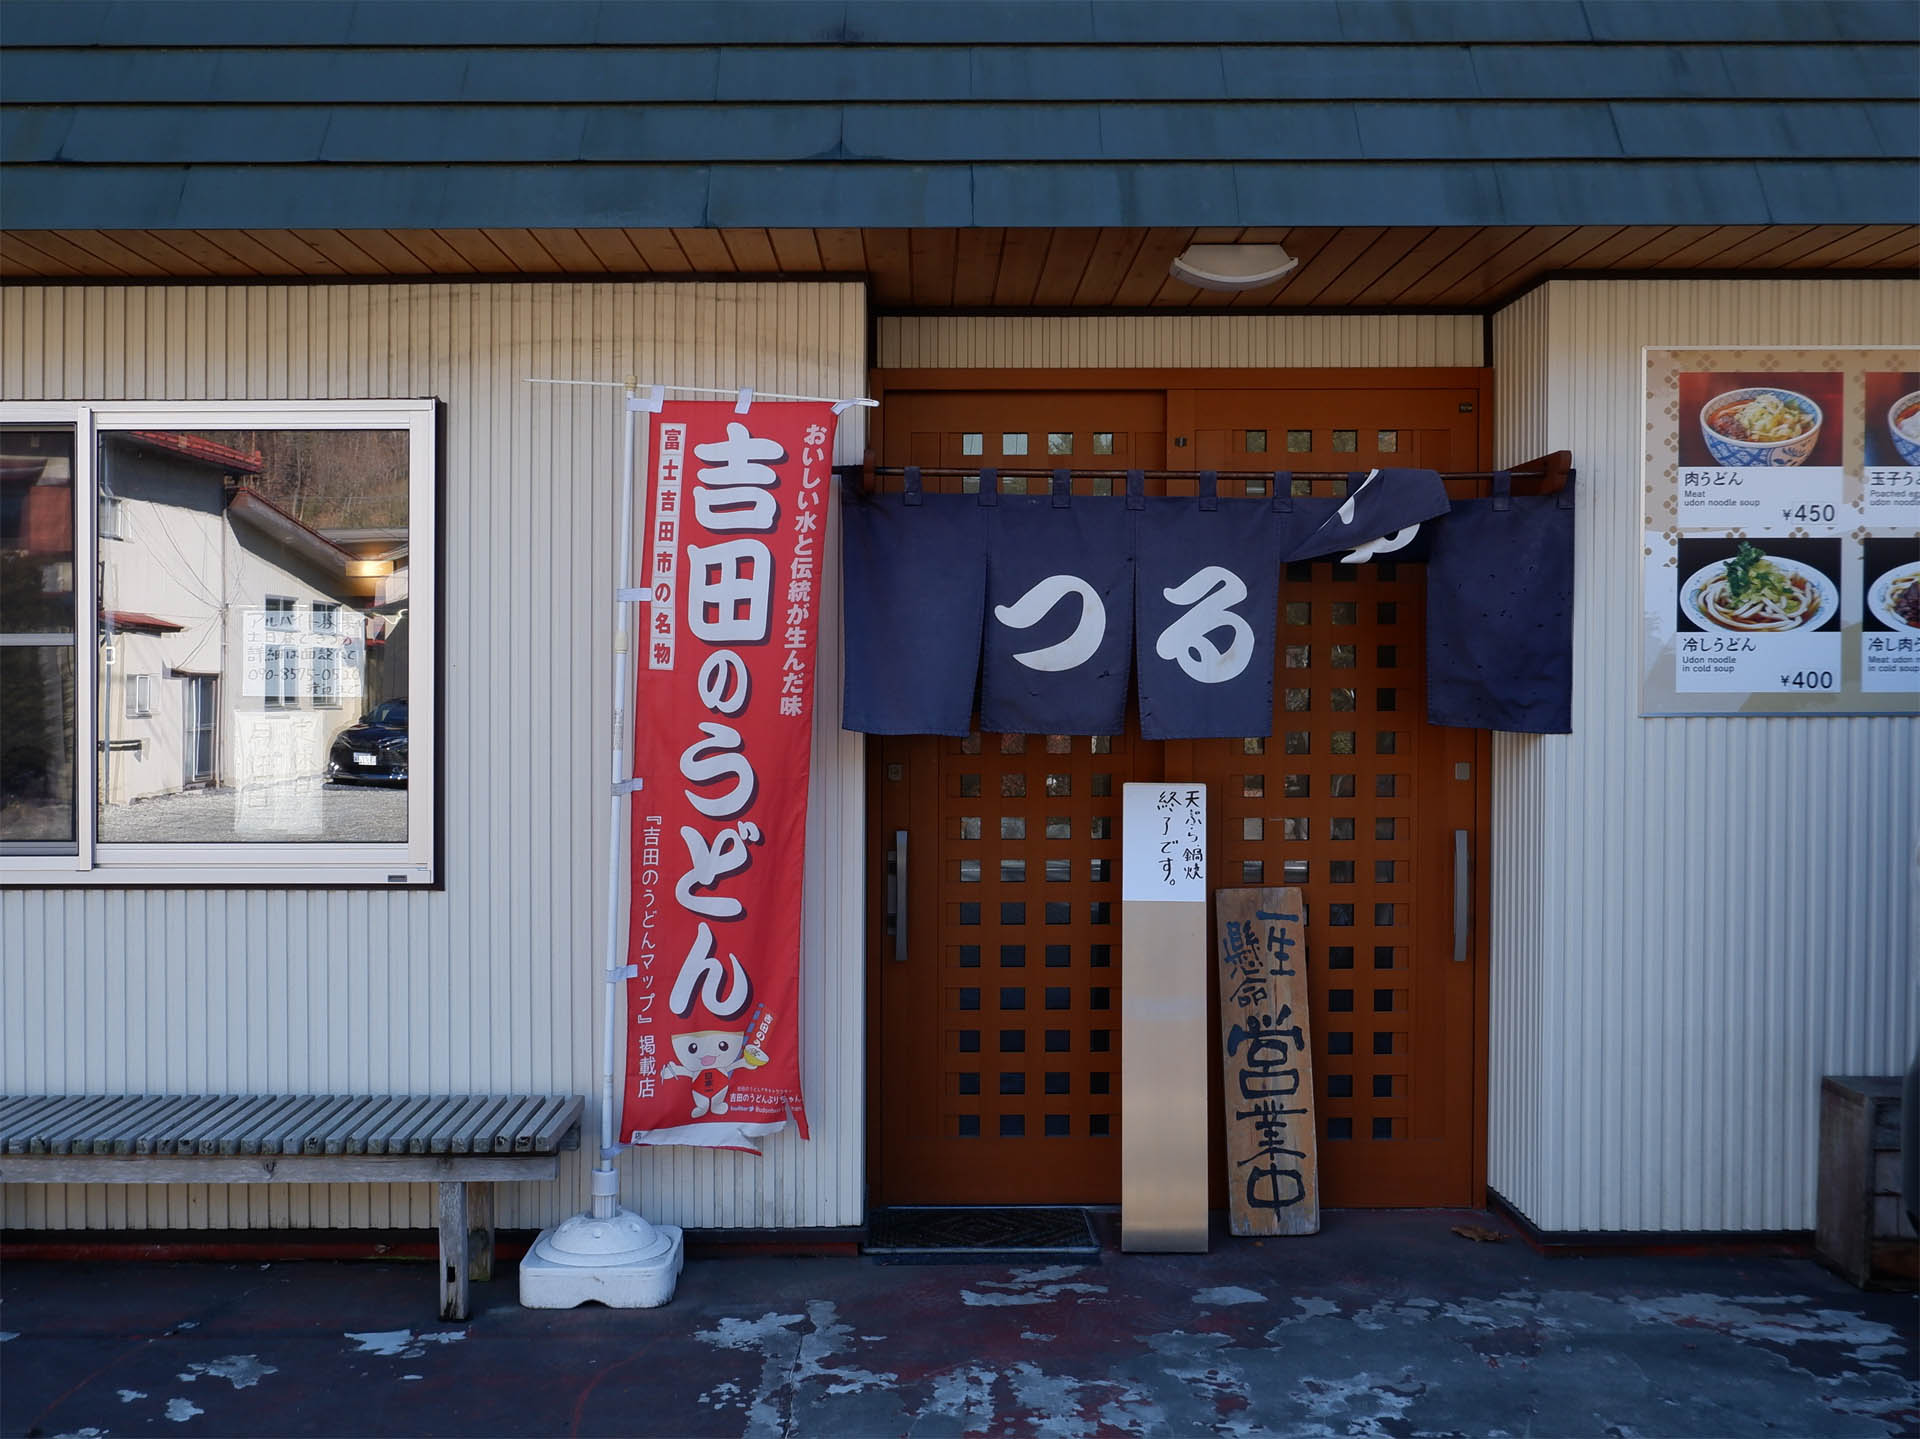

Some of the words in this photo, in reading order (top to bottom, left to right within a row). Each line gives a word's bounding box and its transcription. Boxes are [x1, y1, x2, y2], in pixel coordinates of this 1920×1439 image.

[1684, 471, 1744, 487] 肉うどん
[1871, 471, 1920, 487] 玉子う
[1684, 490, 1706, 498] Meat
[1684, 499, 1706, 507] udon
[1708, 499, 1737, 507] noodle
[1739, 499, 1761, 508] soup
[1782, 504, 1836, 523] ¥450
[653, 428, 683, 666] 富士吉田市の名物
[780, 424, 827, 717] おいしい水と伝統が生んだ味
[1682, 637, 1757, 653] 冷しうどん
[1682, 656, 1705, 664] Udon
[1707, 656, 1737, 664] noodle
[1868, 655, 1889, 663] Meat
[1682, 665, 1691, 673] in
[1693, 665, 1711, 673] cold
[1713, 665, 1735, 673] soup
[1781, 671, 1834, 689] ¥400
[669, 422, 787, 1019] 吉田のうどん
[1156, 791, 1182, 886] 終了です。
[1256, 910, 1299, 976] 一生
[1223, 919, 1267, 1008] 懸命
[1227, 1004, 1308, 1222] 営業中
